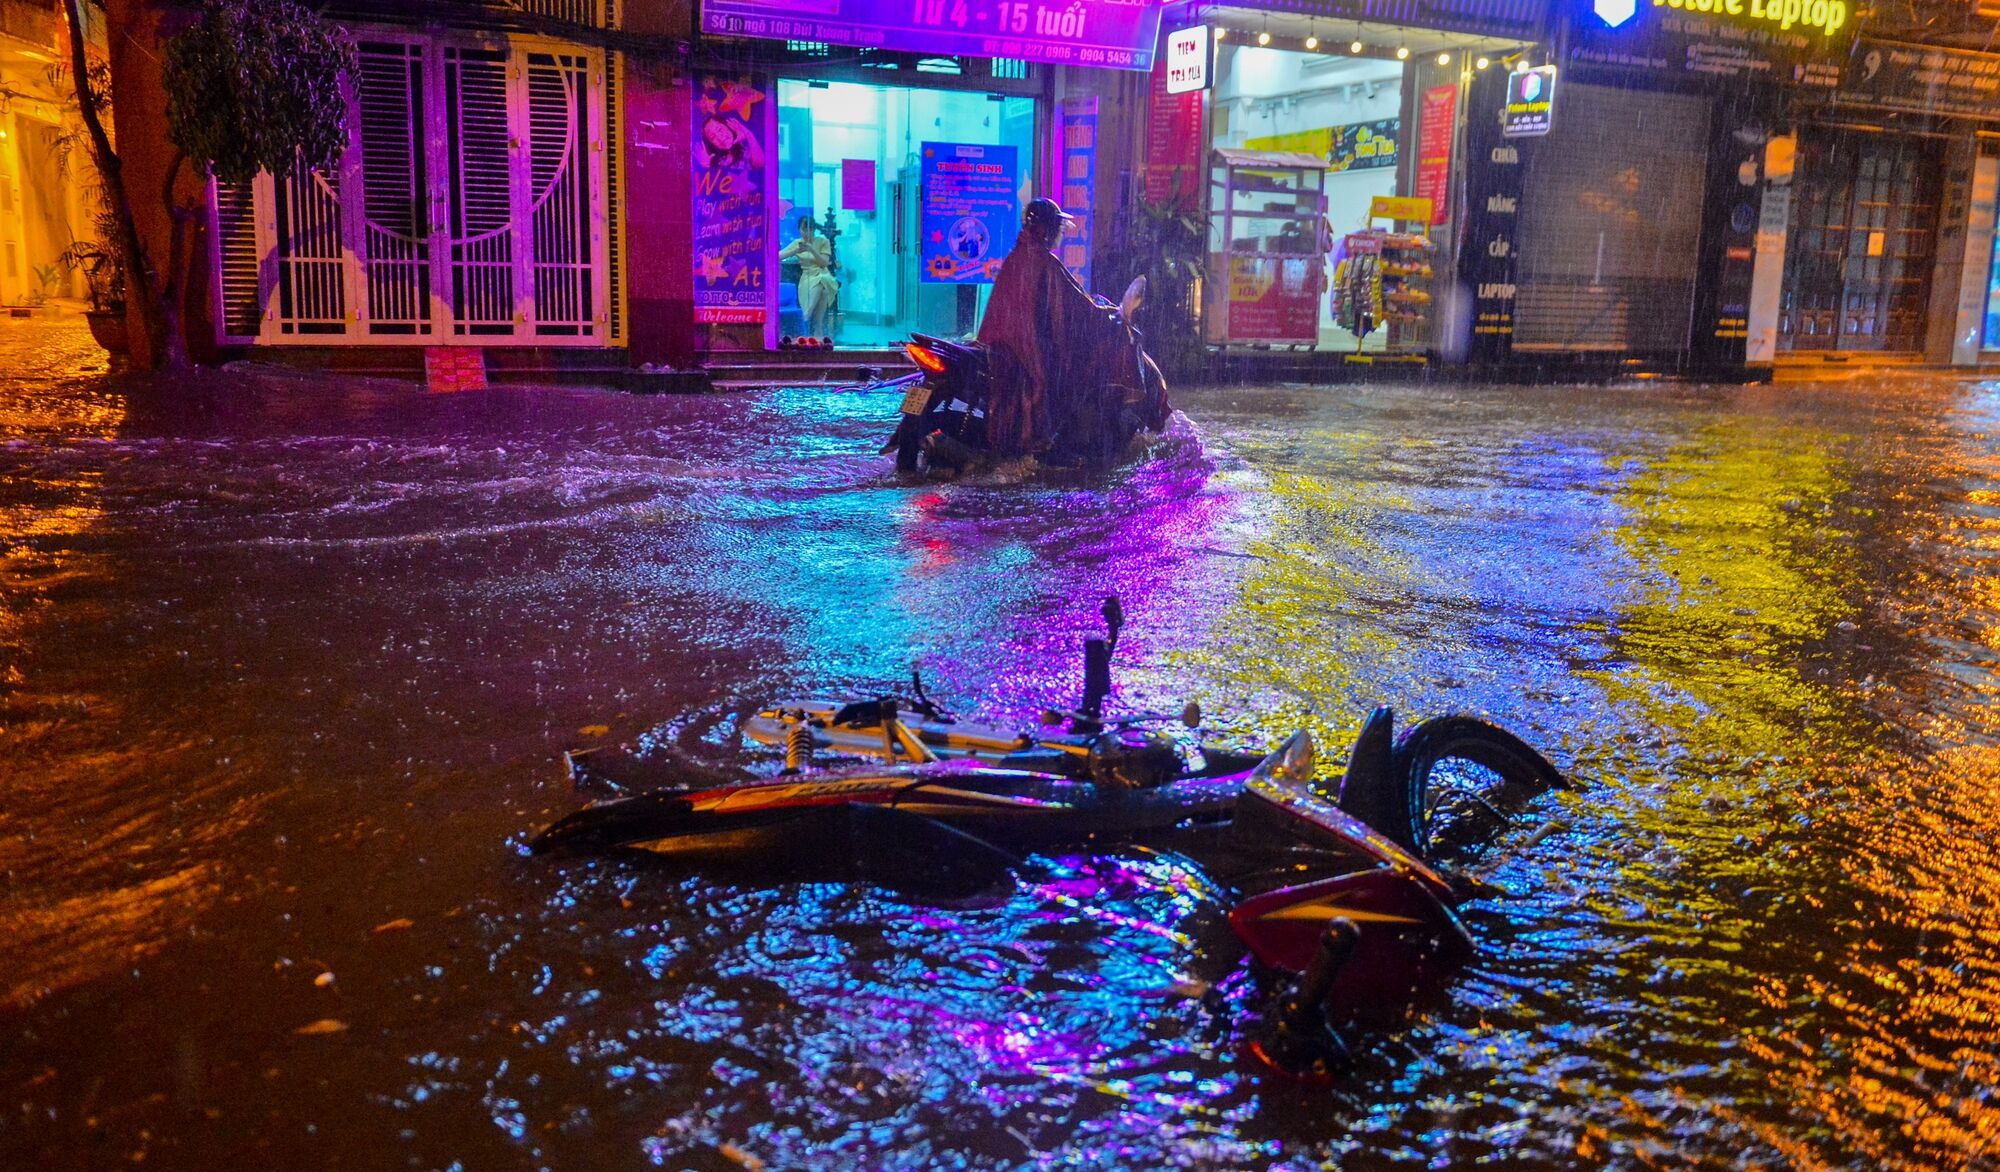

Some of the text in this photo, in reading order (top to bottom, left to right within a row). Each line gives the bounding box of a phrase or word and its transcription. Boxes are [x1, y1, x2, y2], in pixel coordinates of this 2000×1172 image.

[727, 16, 742, 32] 10
[770, 20, 791, 35] 108
[949, 0, 968, 28] 4
[976, 11, 988, 21] -
[998, 1, 1029, 34] 15
[1036, 1, 1087, 38] tuổi
[1750, 0, 1845, 35] Laptop
[1024, 43, 1044, 57] 227
[1046, 44, 1071, 59] 0906
[1080, 47, 1105, 62] 0904
[1107, 49, 1133, 65] 5454
[1134, 52, 1147, 66] 36
[976, 163, 1003, 174] SINH
[695, 169, 733, 196] We
[719, 194, 741, 213] with
[722, 215, 744, 234] with
[721, 240, 744, 258] with
[733, 265, 762, 288] At
[1478, 283, 1517, 299] LAPTOP
